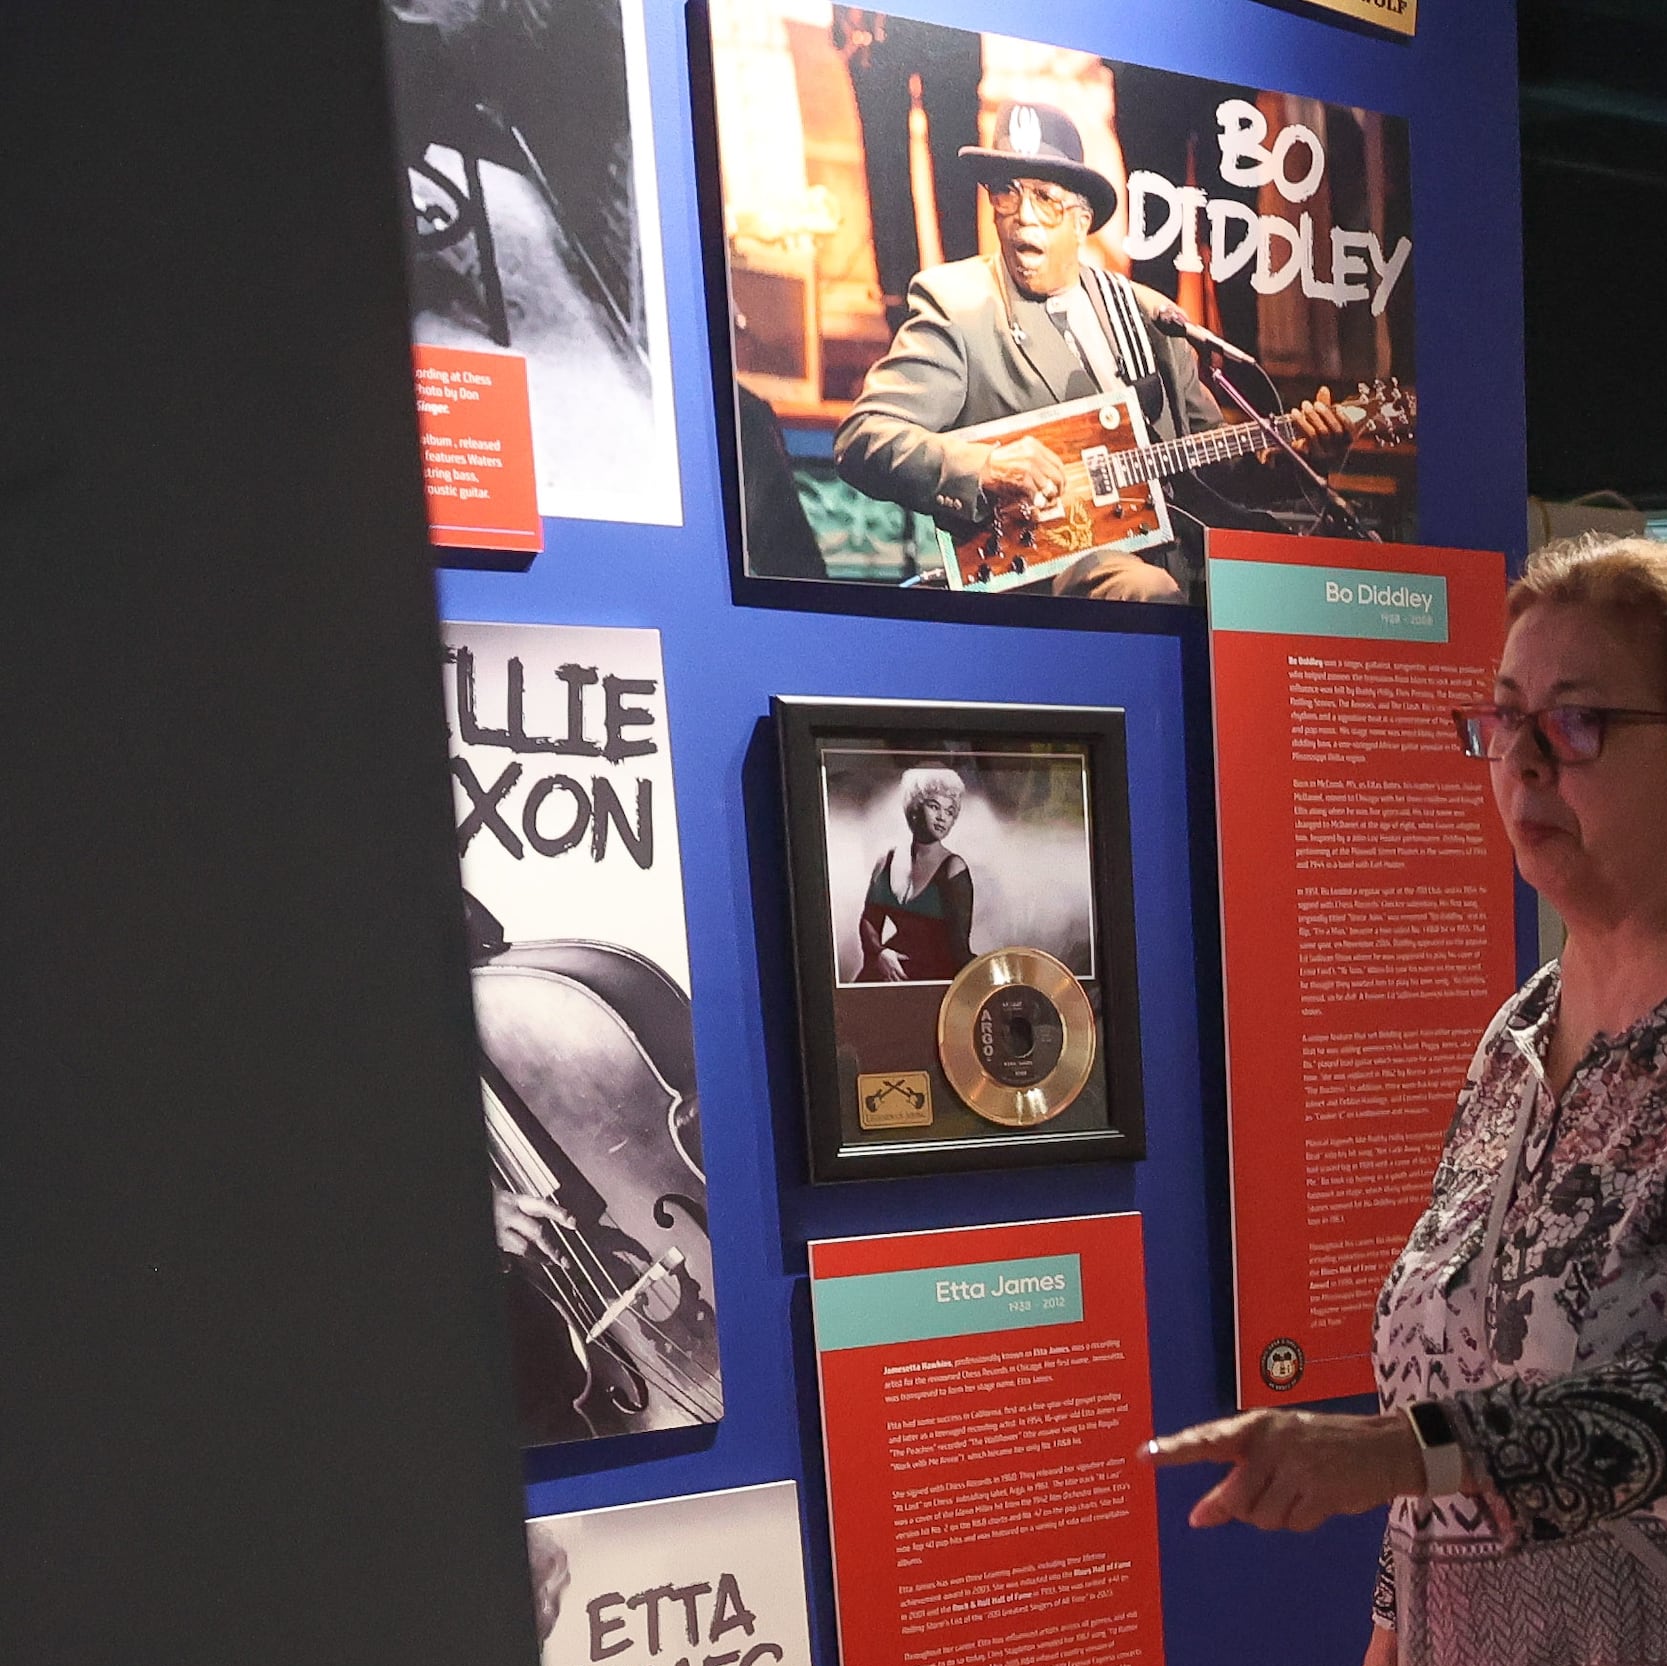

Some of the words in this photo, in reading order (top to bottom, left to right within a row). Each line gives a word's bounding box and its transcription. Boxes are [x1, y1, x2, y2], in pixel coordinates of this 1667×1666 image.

[1216, 99, 1326, 203] BO
[1122, 170, 1412, 317] DIDDLEY
[463, 371, 492, 386] Chess
[444, 386, 458, 401] by
[460, 387, 480, 400] Don
[459, 437, 502, 452] released
[1326, 581, 1353, 603] Bo
[1358, 584, 1433, 613] Diddley
[936, 1281, 986, 1302] Etta
[991, 1274, 1066, 1297] James
[1043, 1296, 1065, 1309] 2012
[883, 1362, 921, 1375] Jamesetta
[586, 1573, 756, 1662] ETTA
